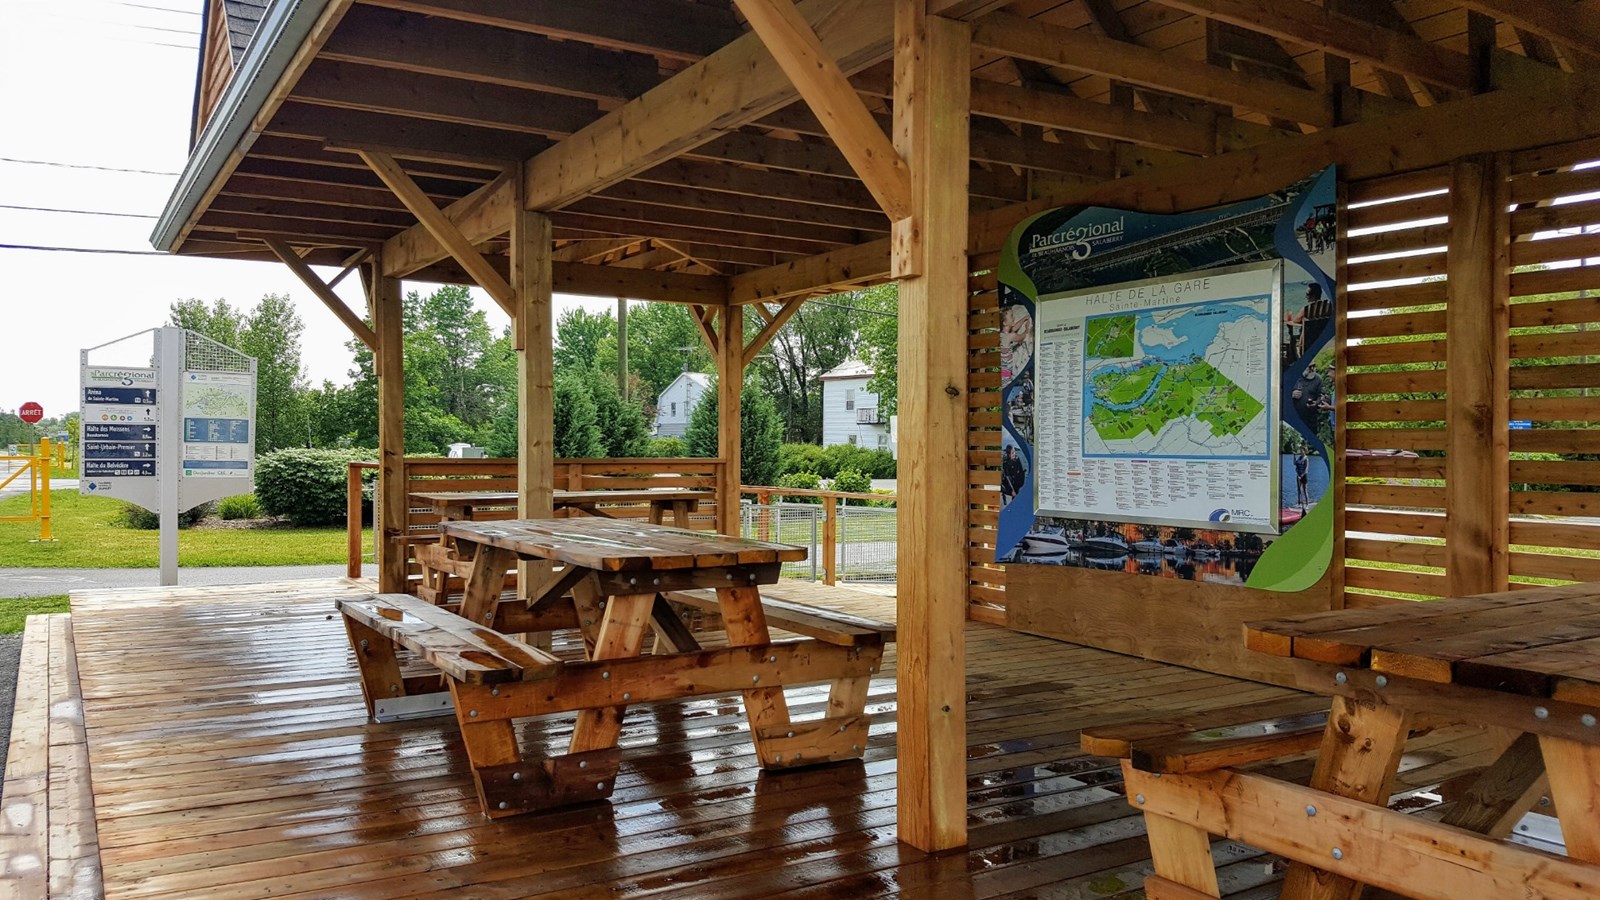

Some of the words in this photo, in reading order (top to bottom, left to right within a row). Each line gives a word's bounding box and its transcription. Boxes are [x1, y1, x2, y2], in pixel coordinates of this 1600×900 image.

[1092, 235, 1124, 247] SALABERRY
[1085, 290, 1124, 306] HALTE
[1128, 287, 1145, 300] DE
[1151, 284, 1167, 297] LA
[1173, 278, 1211, 294] GARE
[1109, 295, 1181, 312] Sainte-Martine
